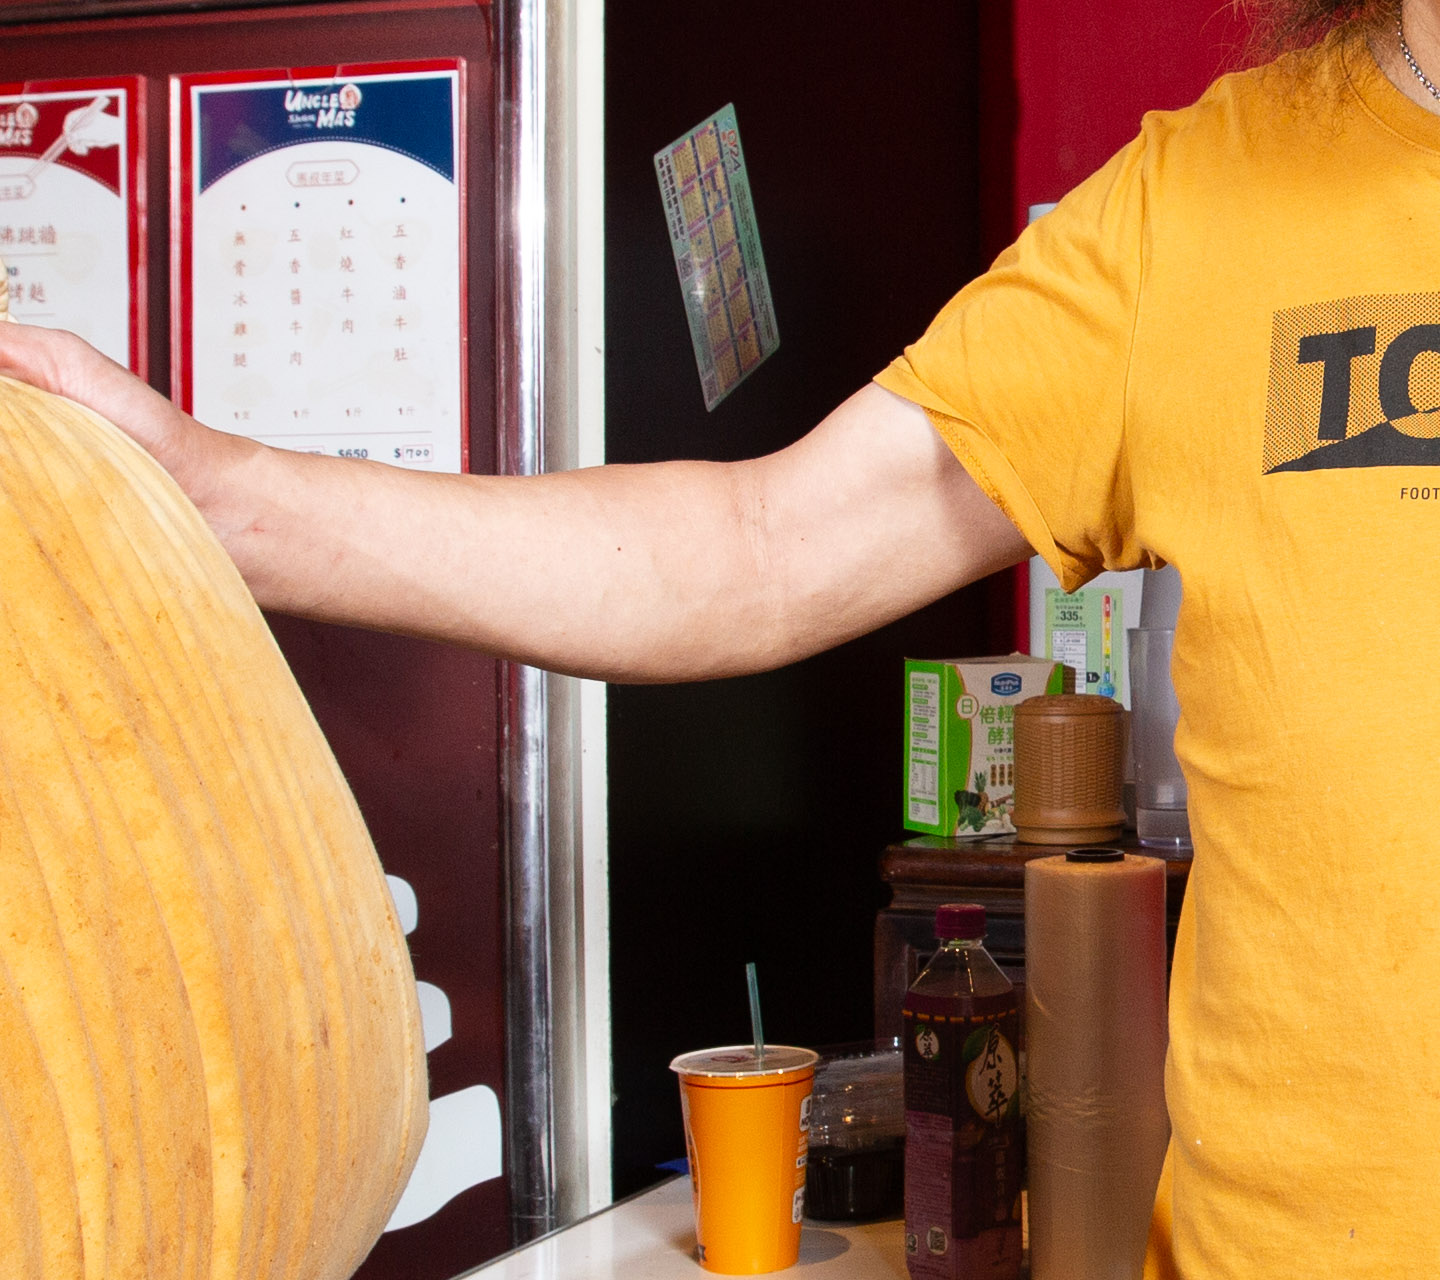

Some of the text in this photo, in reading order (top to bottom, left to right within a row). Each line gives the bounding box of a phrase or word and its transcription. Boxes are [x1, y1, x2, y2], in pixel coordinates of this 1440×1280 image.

[284, 89, 340, 112] UNCLE
[340, 226, 355, 335] 紅燒牛肉
[1060, 610, 1079, 622] 335
